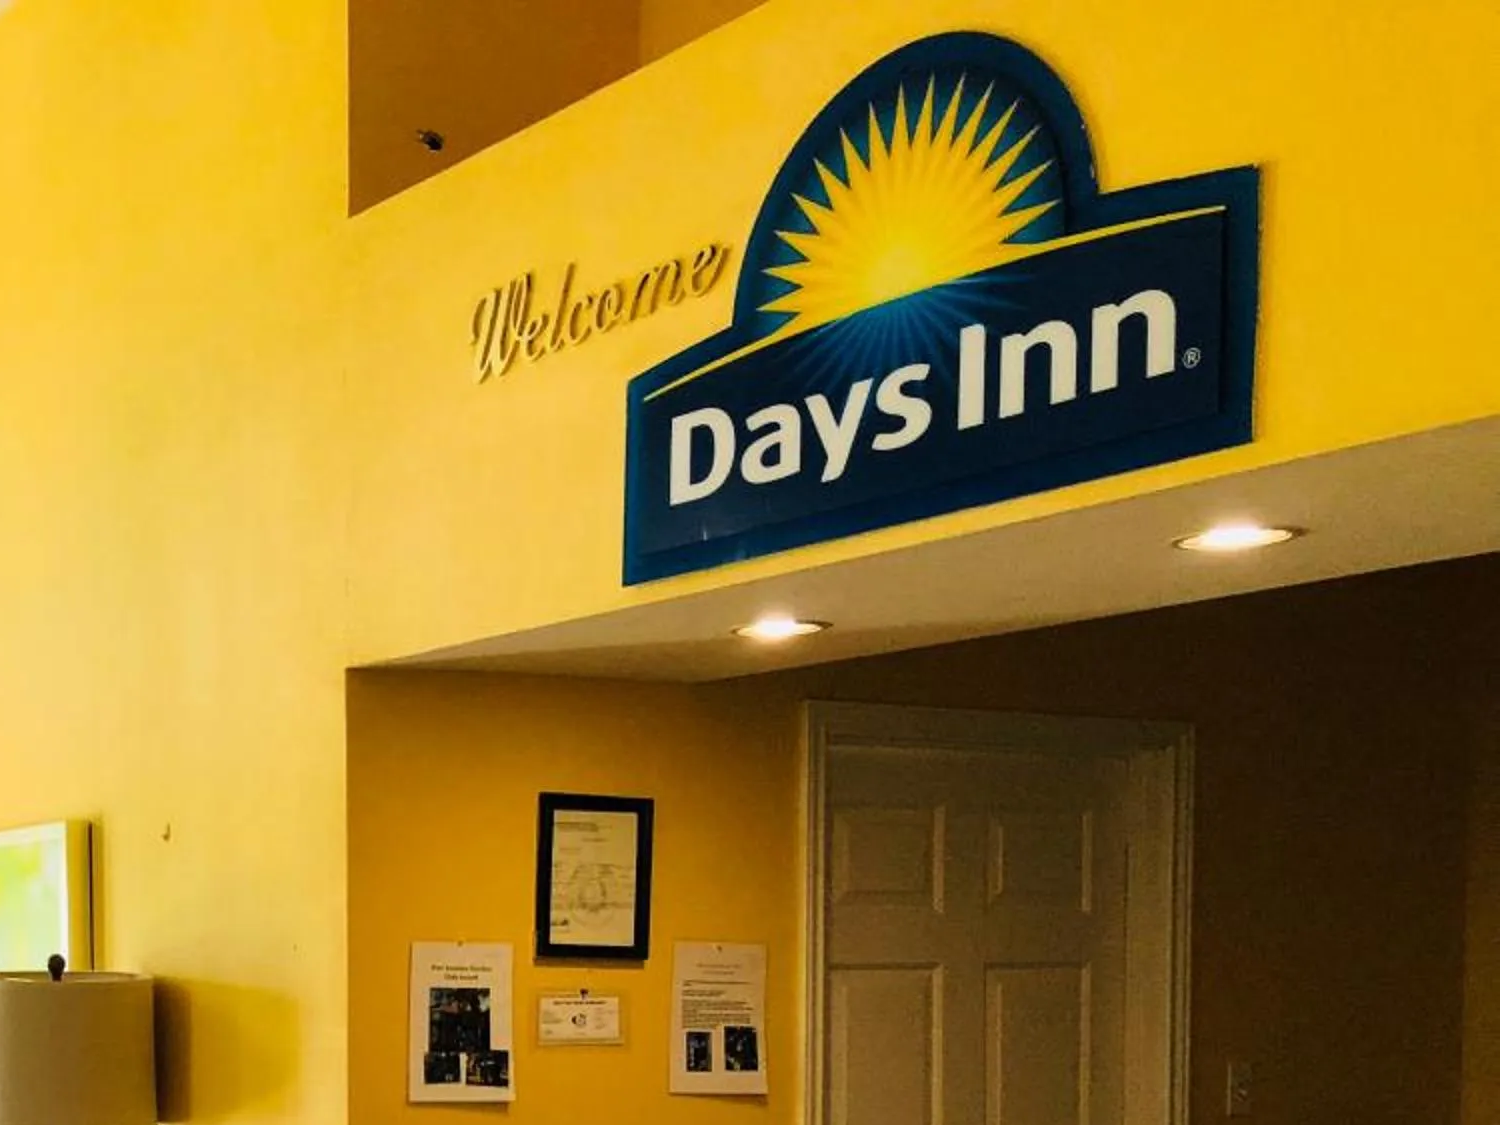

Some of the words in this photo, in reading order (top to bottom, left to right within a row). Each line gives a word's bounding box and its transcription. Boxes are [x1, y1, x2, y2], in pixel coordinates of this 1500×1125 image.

[472, 244, 729, 384] Welcome
[668, 361, 931, 507] Days
[957, 288, 1178, 432] Inn
